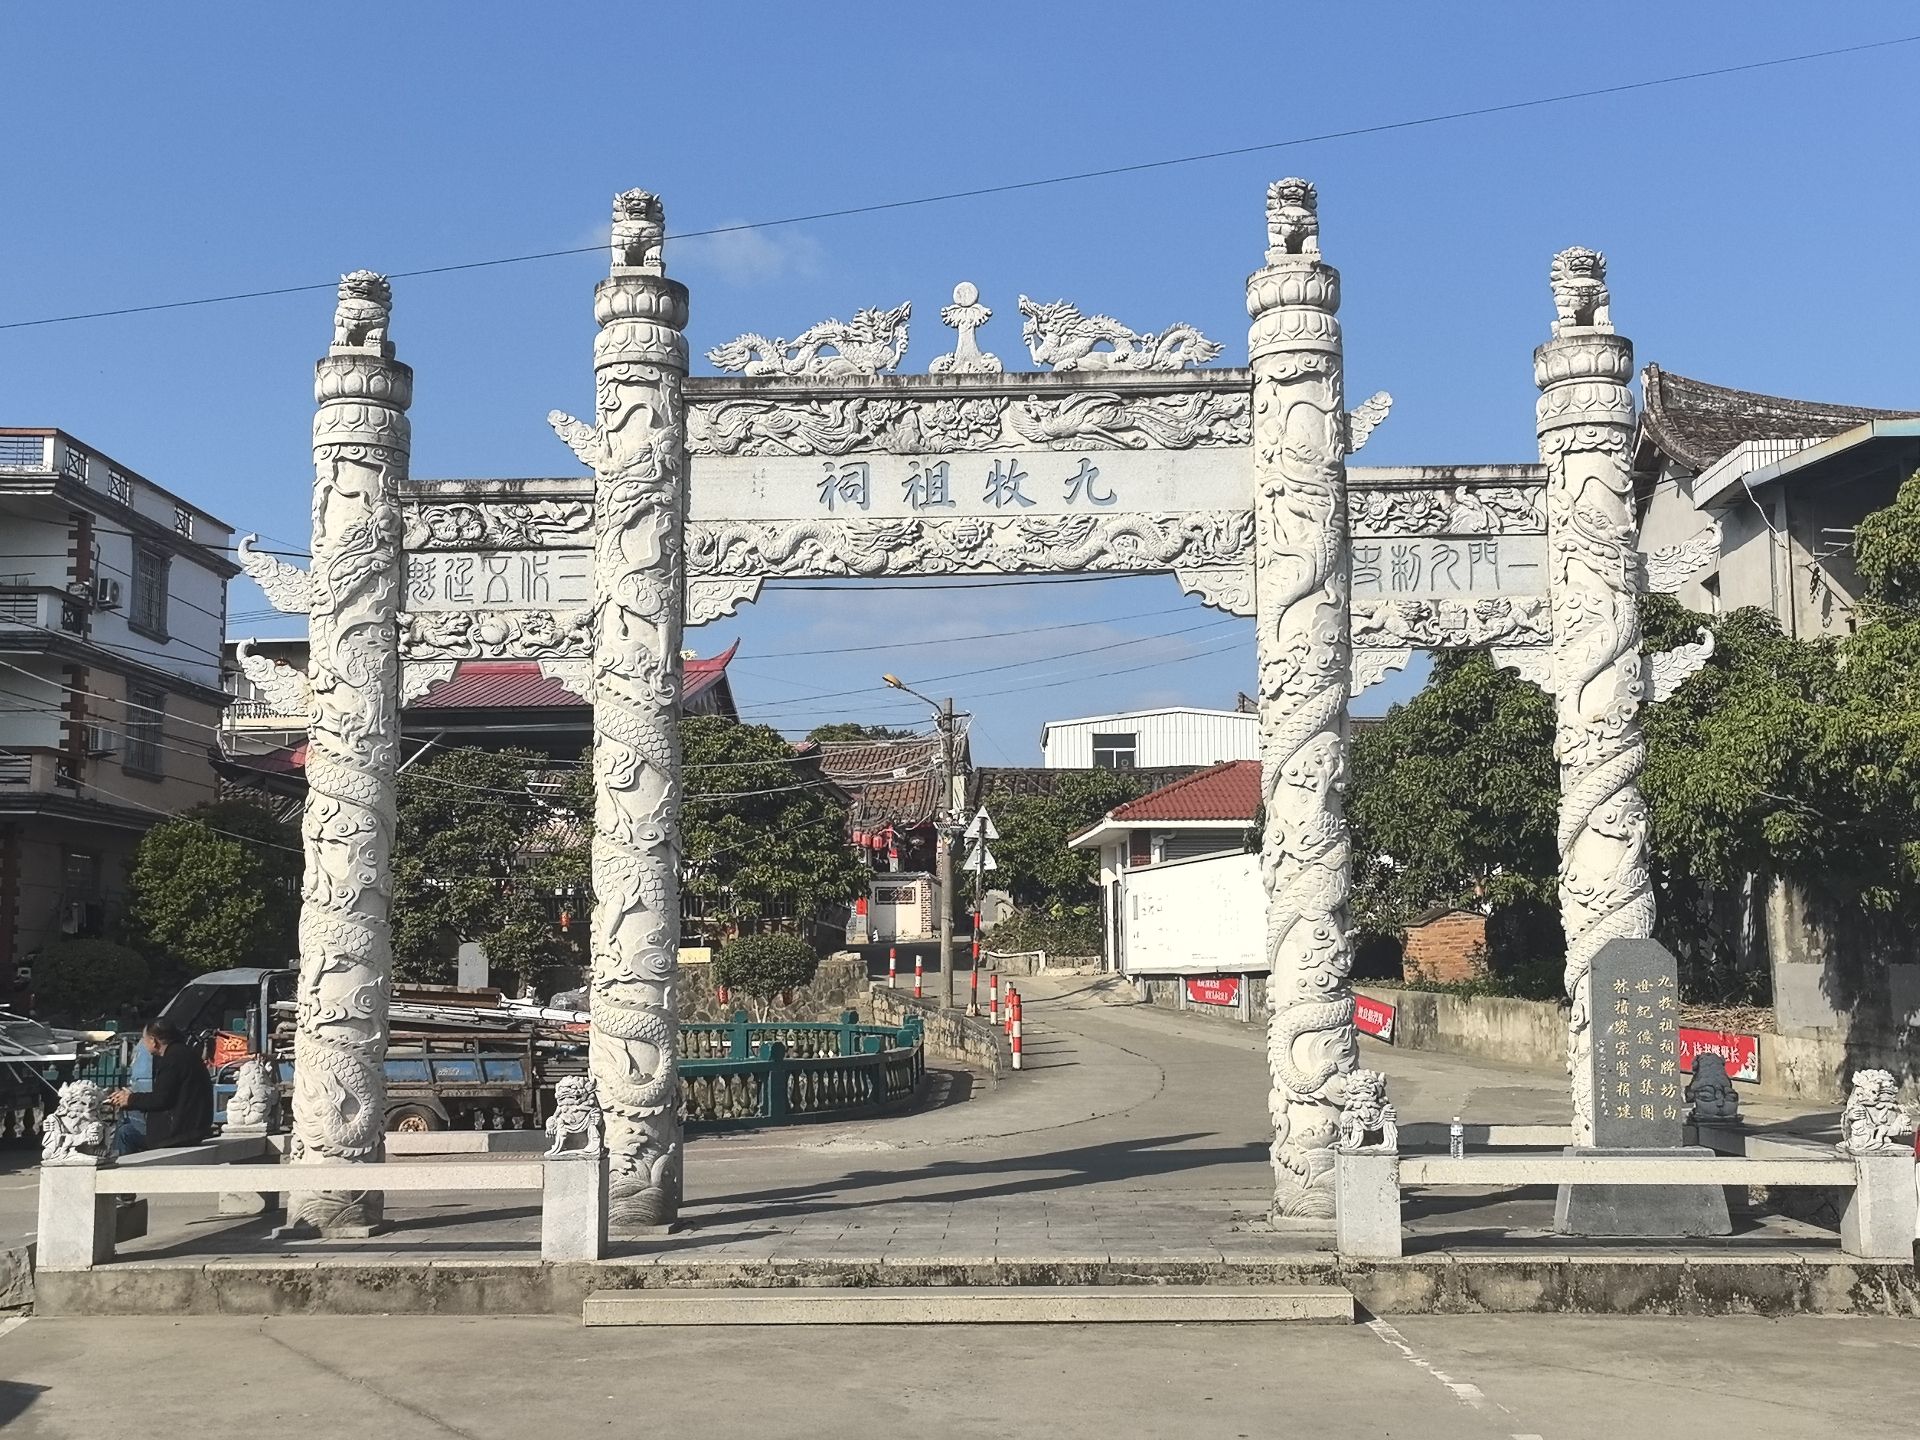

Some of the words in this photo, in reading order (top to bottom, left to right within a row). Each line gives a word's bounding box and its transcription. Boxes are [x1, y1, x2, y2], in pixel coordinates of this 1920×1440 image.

[816, 456, 1118, 512] 九牧祖祠
[1657, 974, 1678, 1120] 九牧祖祠牌坊由
